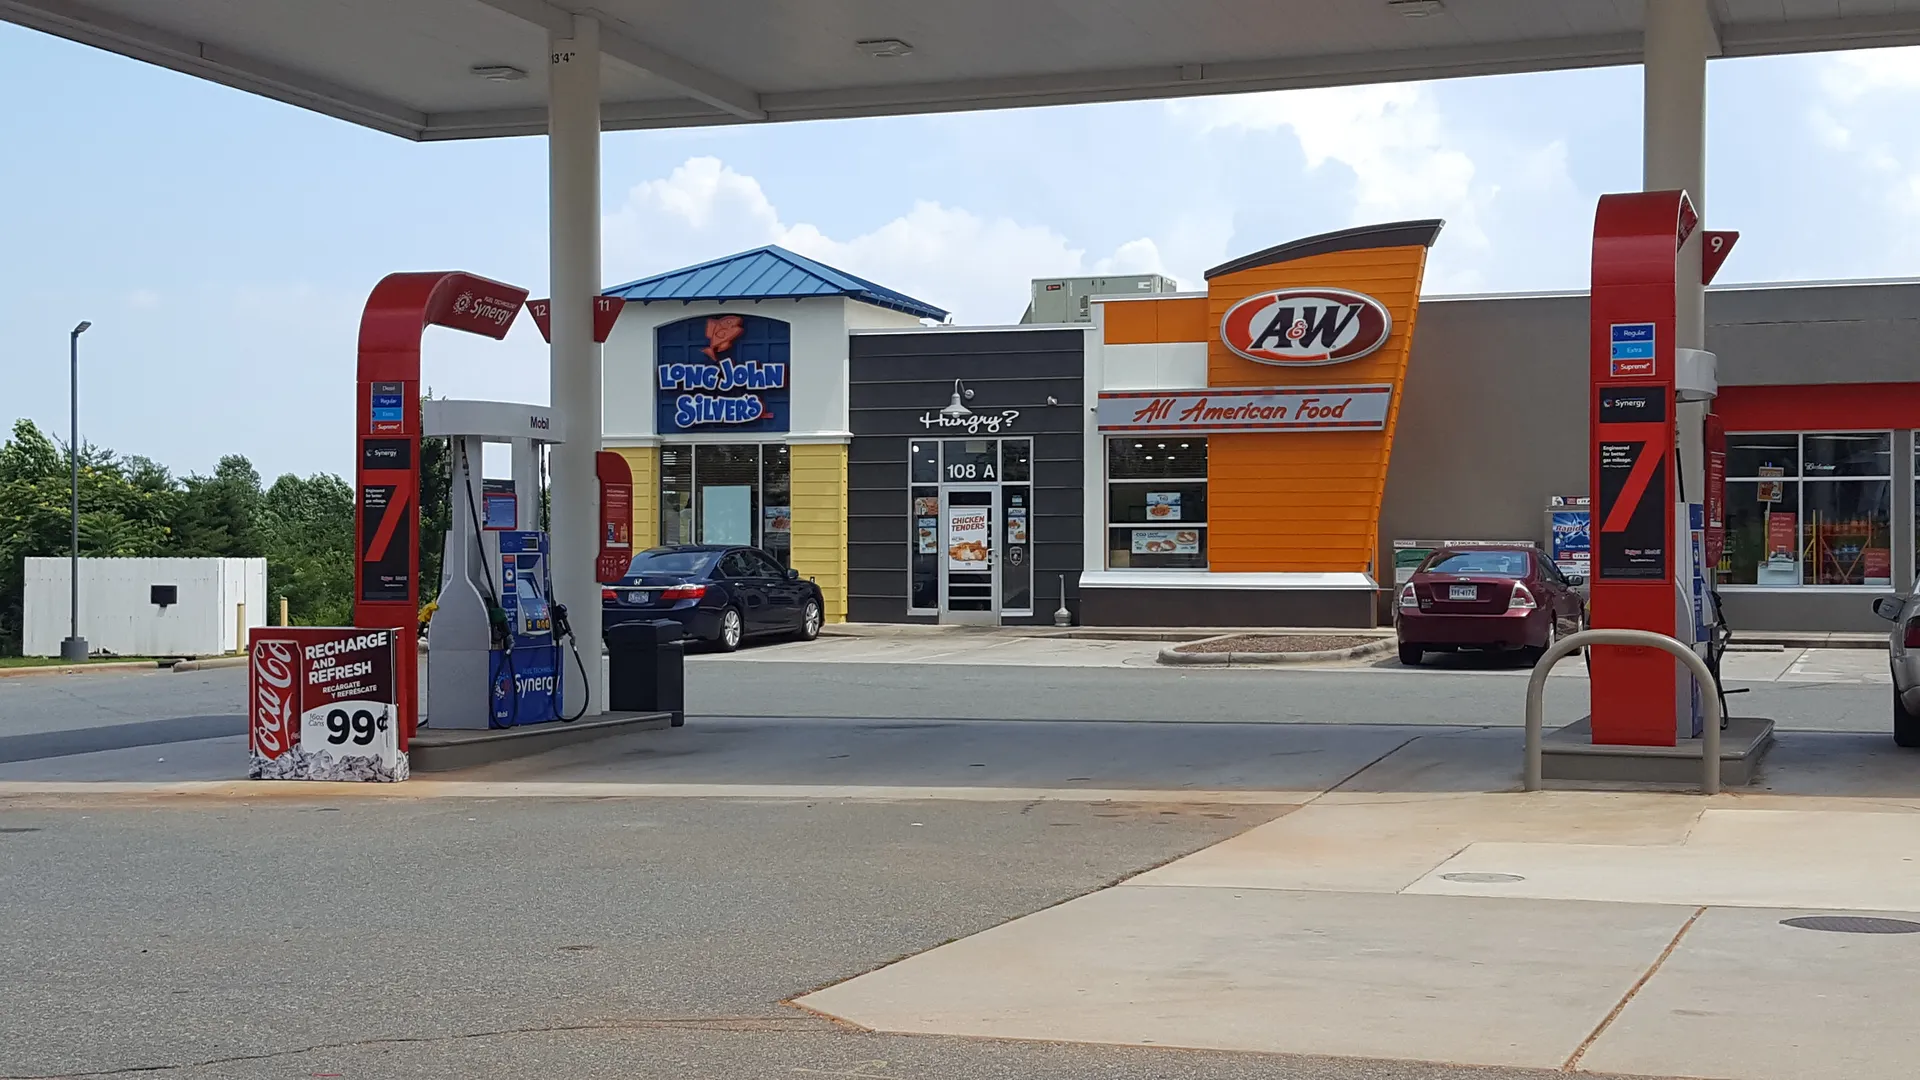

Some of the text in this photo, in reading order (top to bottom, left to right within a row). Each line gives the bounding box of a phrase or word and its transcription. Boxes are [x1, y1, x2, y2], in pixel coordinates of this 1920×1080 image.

[1710, 236, 1724, 253] 9
[470, 298, 514, 326] Synergy
[534, 304, 547, 318] 12
[598, 299, 610, 312] 11
[1248, 303, 1365, 350] A&W
[1623, 329, 1646, 338] Regular
[1626, 346, 1642, 354] Extra
[658, 357, 786, 391] LONG JOHN
[675, 393, 763, 428] SILVER'S
[1132, 397, 1352, 423] All American Food
[1615, 399, 1646, 408] Synergy
[530, 416, 550, 430] Mobil
[919, 410, 1020, 434] Hungry?
[374, 449, 397, 457] Synergy
[947, 463, 995, 479] 108 A
[951, 515, 985, 525] CHICKEN
[951, 522, 985, 532] TENDERS
[1555, 525, 1583, 533] Rapid
[305, 631, 388, 660] RECHARGE
[311, 657, 336, 671] AND
[308, 660, 372, 685] REFRESH
[326, 708, 389, 746] 99¢
